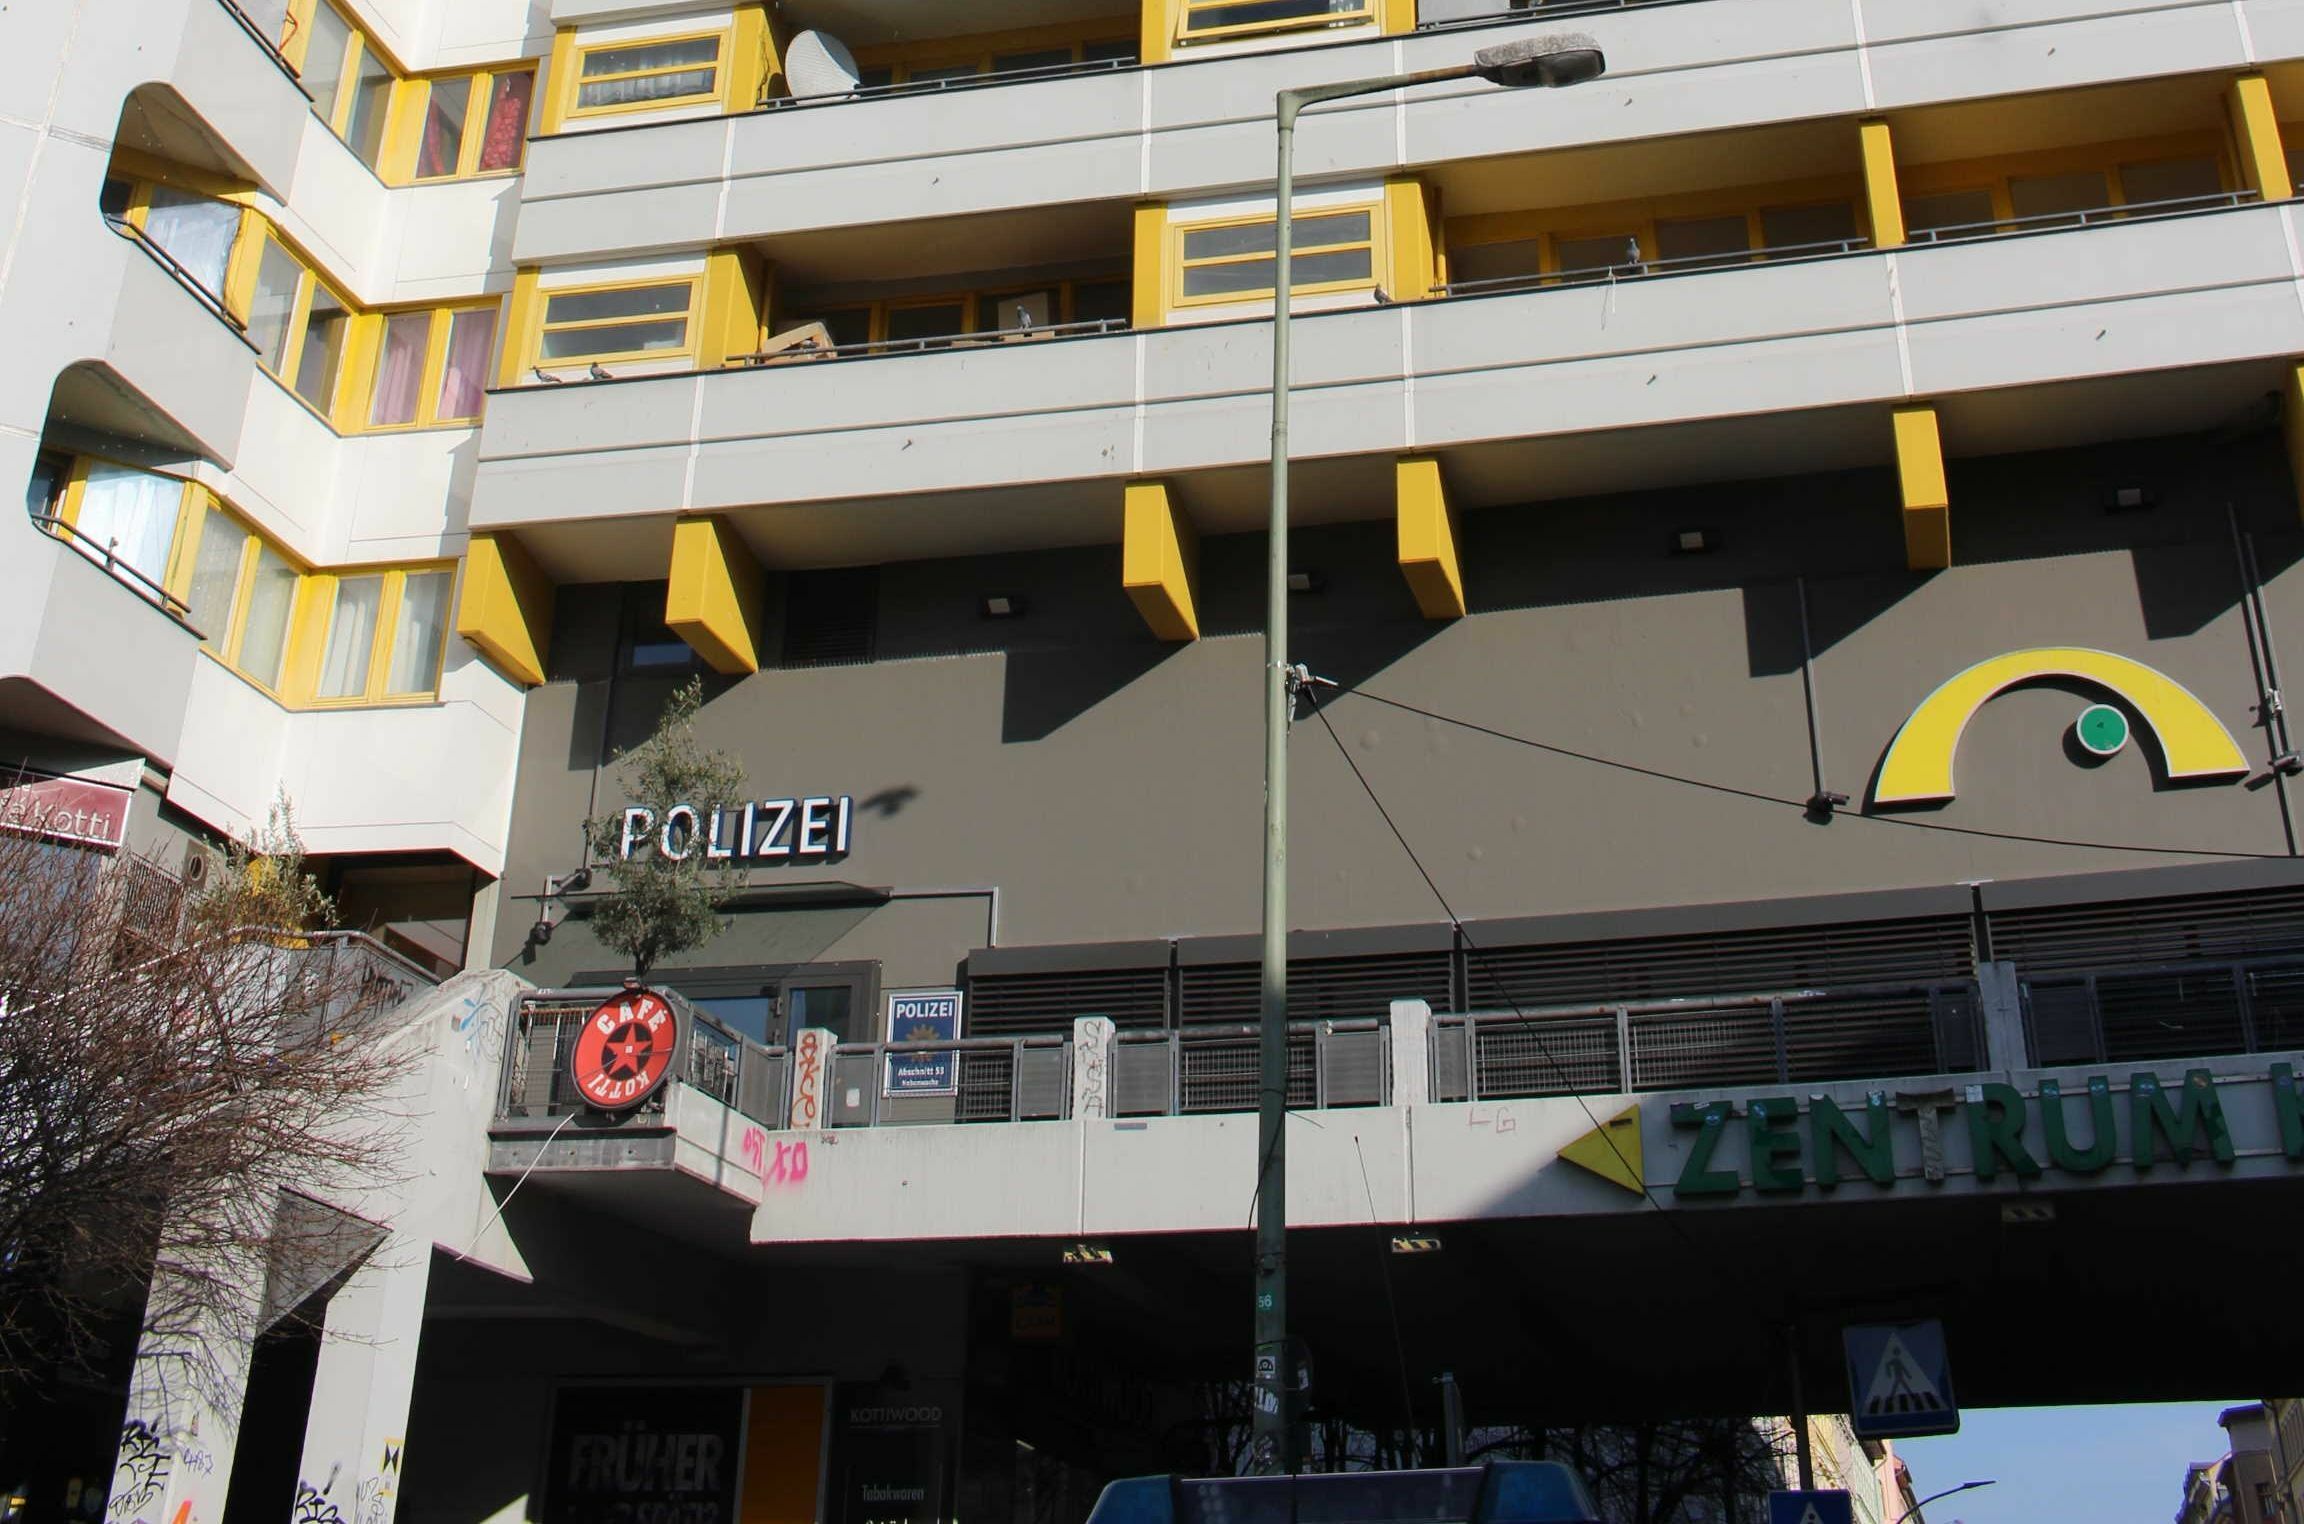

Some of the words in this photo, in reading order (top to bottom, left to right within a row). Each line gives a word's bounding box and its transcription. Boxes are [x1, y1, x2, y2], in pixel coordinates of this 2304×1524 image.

[33, 799, 111, 840] Kotti
[620, 795, 853, 861] POLIZEI
[596, 998, 668, 1036] CAFÉ
[896, 1001, 953, 1019] POLIZEI
[587, 1070, 650, 1099] KOTTI
[897, 1067, 934, 1077] Abschnitt
[1669, 1067, 2236, 1197] ZENTRUM
[566, 1418, 727, 1492] FRÜHER
[861, 1483, 926, 1501] Tabakwaren
